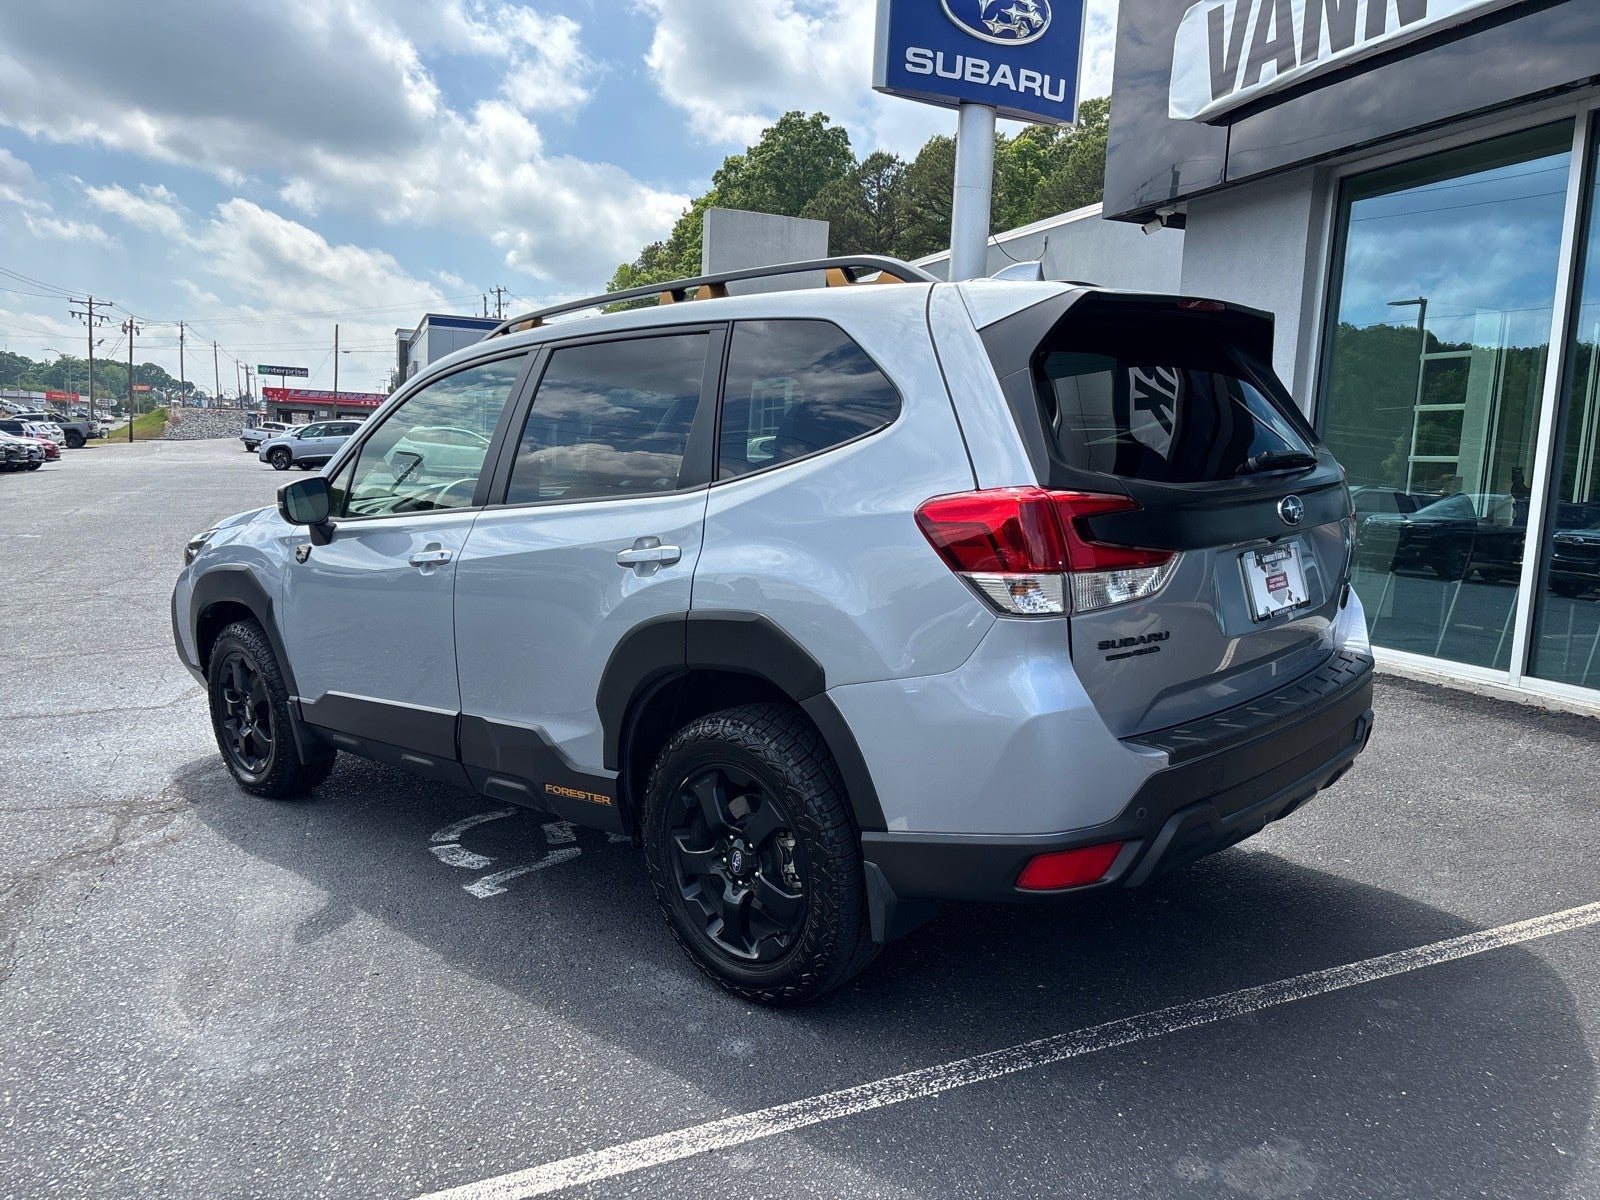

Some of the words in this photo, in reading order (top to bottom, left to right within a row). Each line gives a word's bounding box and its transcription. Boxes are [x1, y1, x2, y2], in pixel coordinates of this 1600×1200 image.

[905, 46, 1066, 103] SUBARU
[259, 366, 308, 375] enterprise
[1097, 630, 1170, 650] SUBARU
[545, 783, 612, 805] FORESTER
